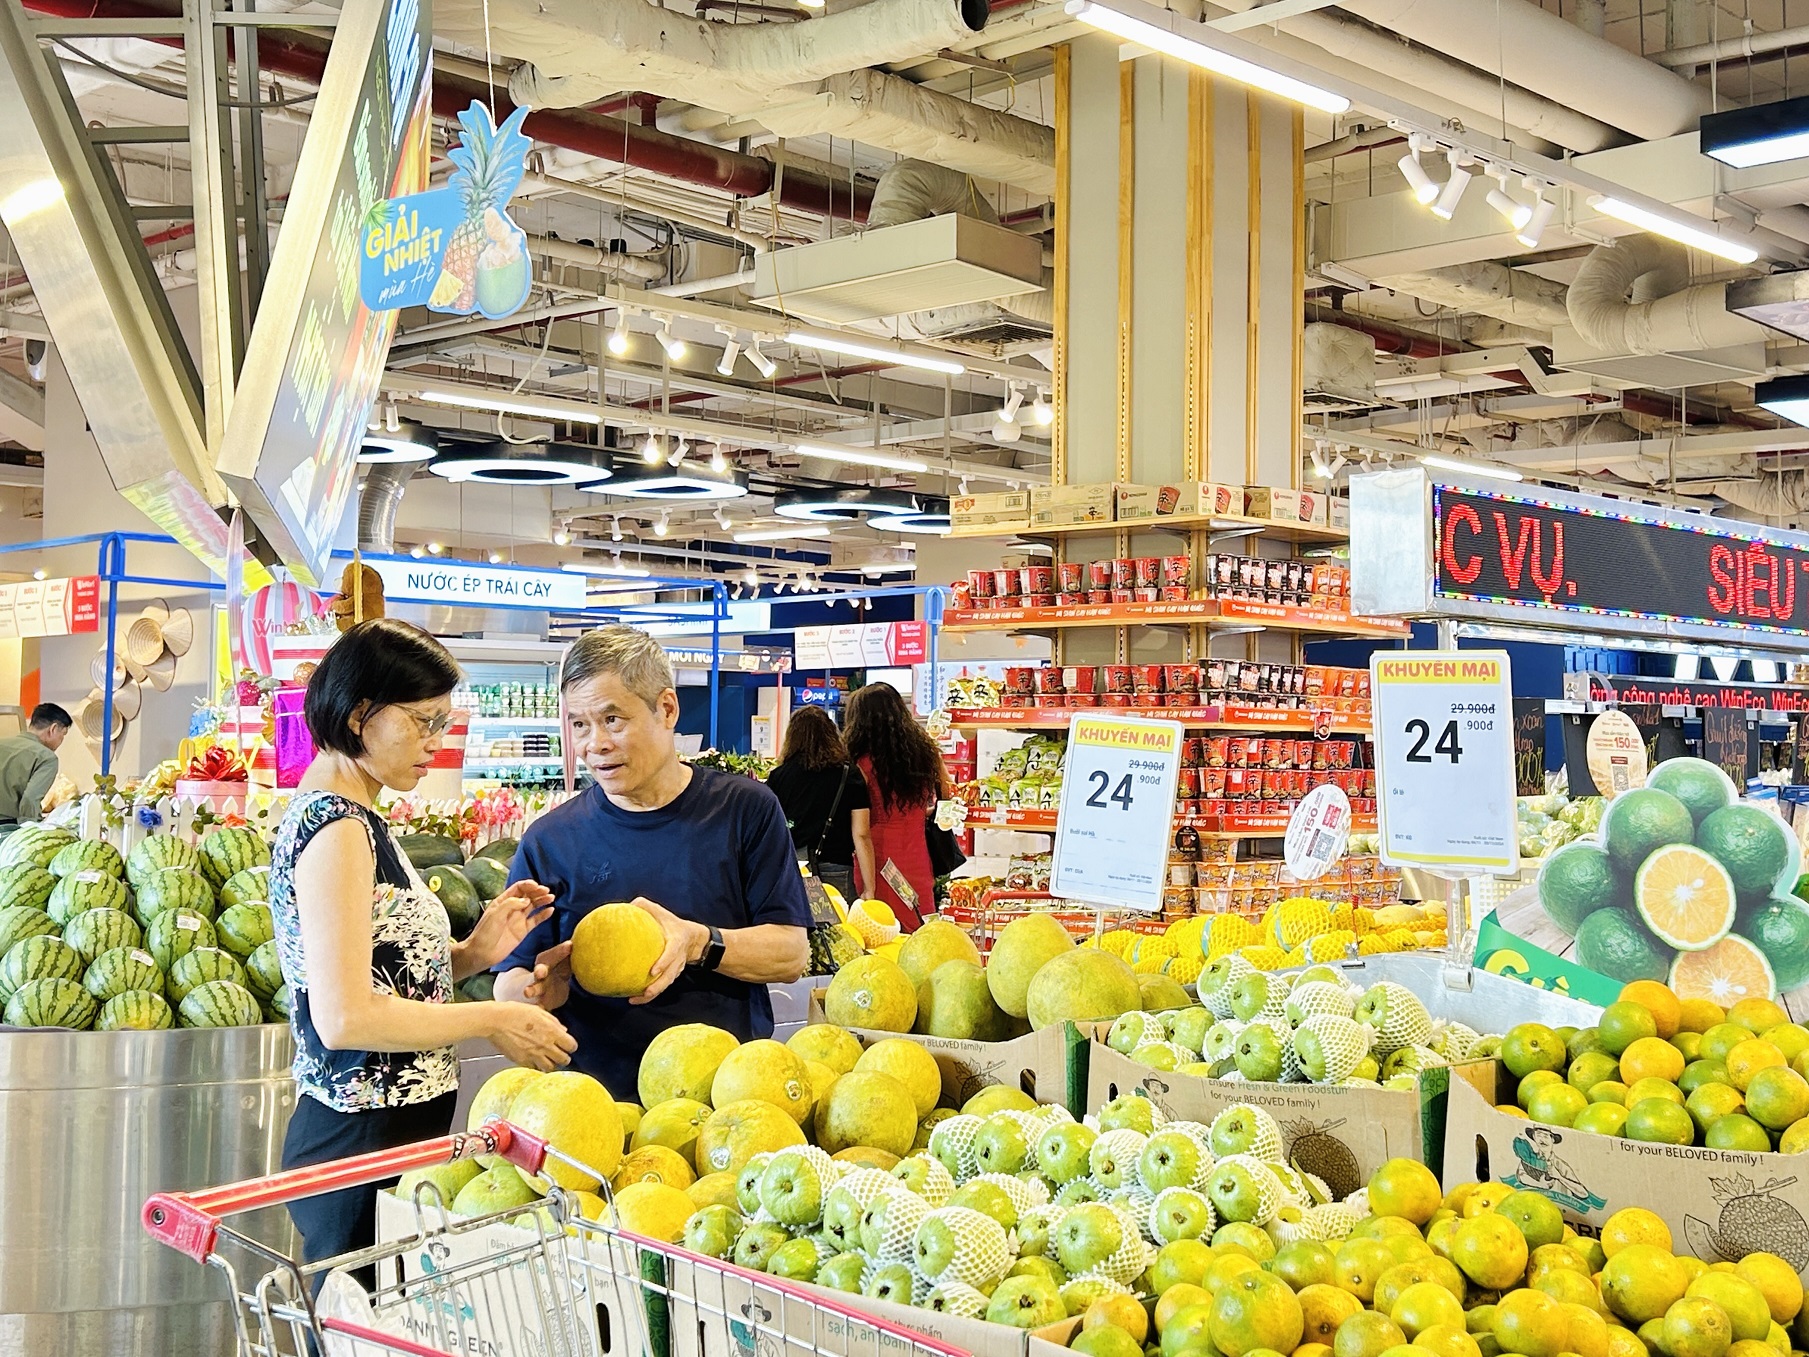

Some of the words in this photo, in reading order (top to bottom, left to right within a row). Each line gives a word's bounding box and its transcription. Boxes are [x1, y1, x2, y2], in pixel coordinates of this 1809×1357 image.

[366, 204, 418, 259] GIẢI
[384, 226, 442, 276] NHIỆT
[408, 571, 458, 591] NƯỚC
[463, 573, 481, 592] ÉP
[486, 577, 519, 595] TRÁI
[523, 579, 552, 598] CÂY
[1708, 541, 1795, 620] SIÊU
[1383, 660, 1456, 677] KHUYẾN
[1462, 662, 1496, 681] MẠI
[1079, 726, 1138, 745] KHUYẾN
[1143, 732, 1171, 750] MẠI
[1404, 719, 1463, 764] 24
[1614, 737, 1630, 749] 150
[1086, 770, 1134, 811] 24
[926, 1039, 959, 1049] BELOVED
[960, 1041, 983, 1053] family
[1210, 1090, 1221, 1099] for
[1223, 1093, 1242, 1103] your
[1244, 1094, 1285, 1106] BELOVED
[1287, 1097, 1315, 1110] family
[1620, 1141, 1635, 1152] for
[1637, 1144, 1662, 1156] your
[1666, 1147, 1718, 1162] BELOVED
[1721, 1152, 1757, 1167] family
